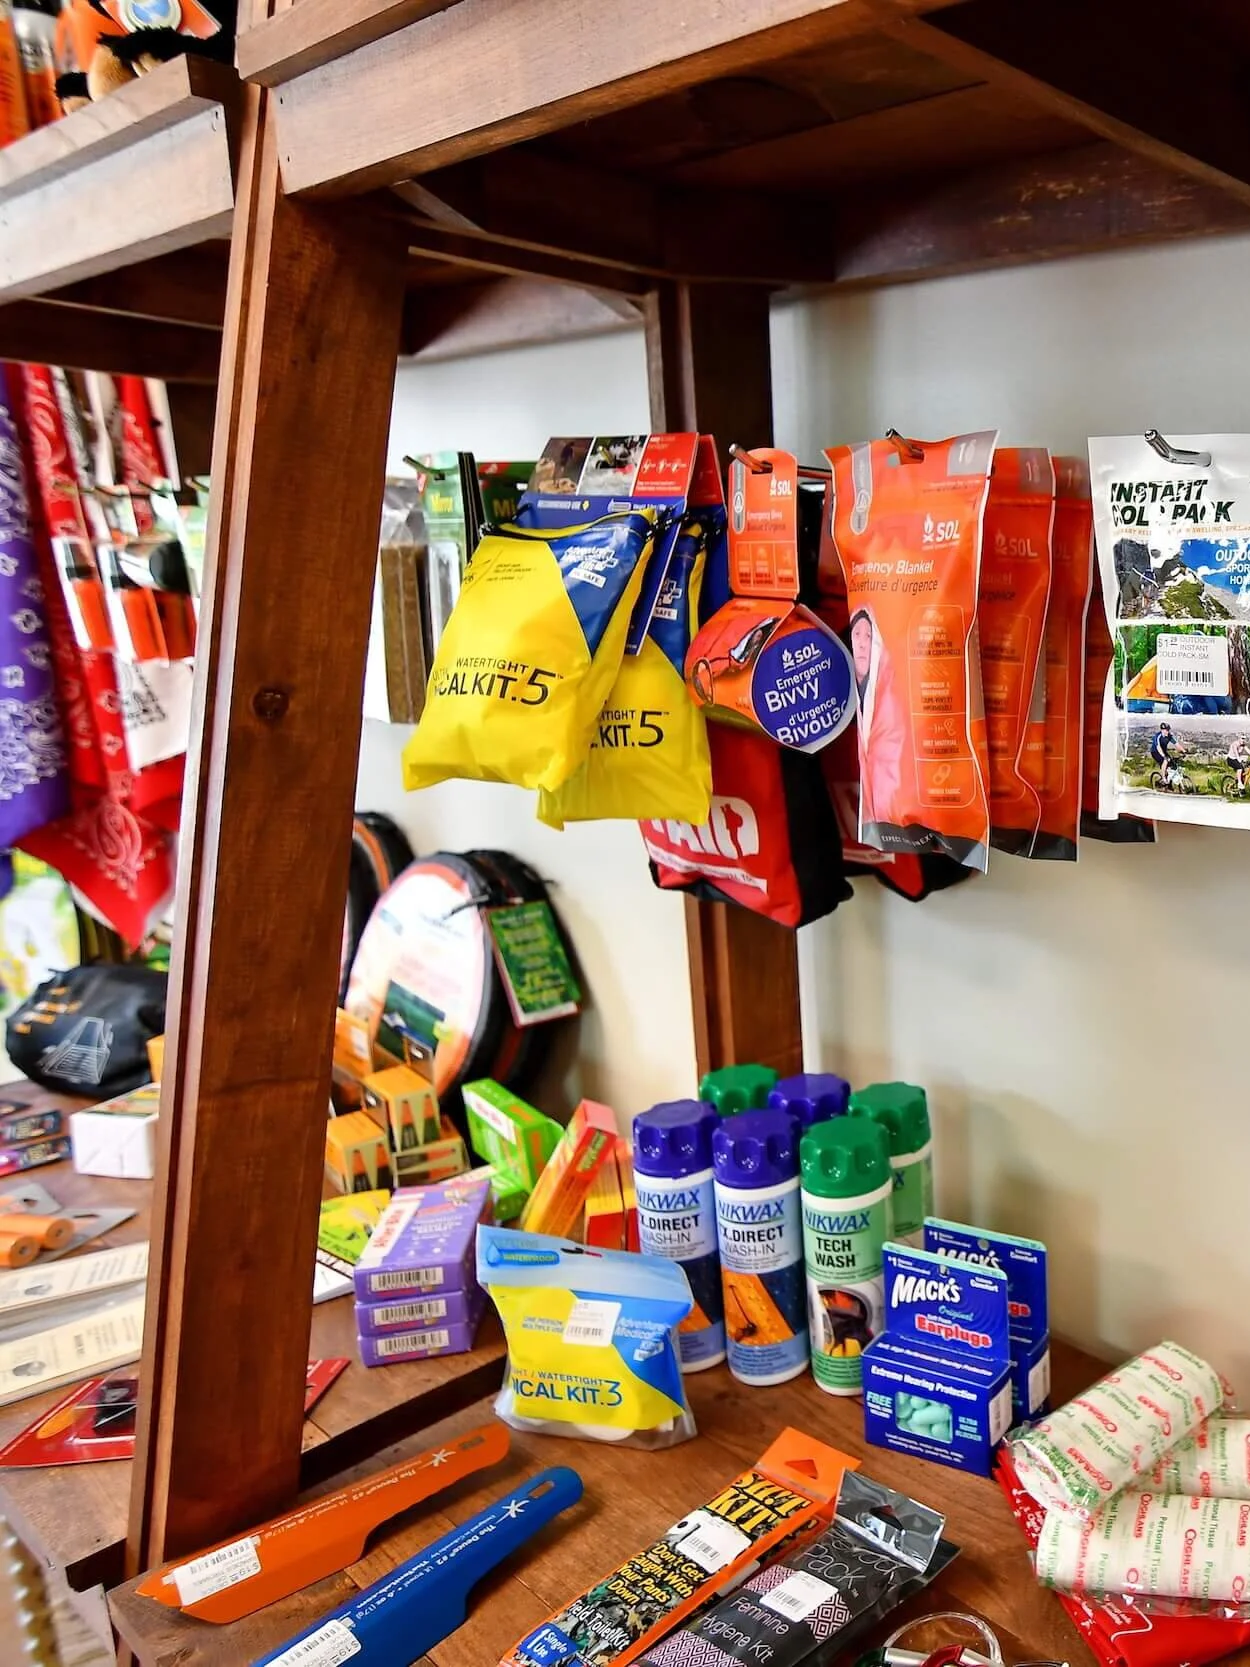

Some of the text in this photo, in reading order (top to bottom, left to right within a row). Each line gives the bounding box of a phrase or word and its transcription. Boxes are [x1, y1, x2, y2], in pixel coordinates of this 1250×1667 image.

[776, 479, 793, 497] SOL
[1111, 504, 1166, 527] COL
[936, 519, 960, 543] SOL
[1008, 538, 1038, 558] SOL
[896, 559, 934, 575] Blanket
[891, 579, 938, 596] d'urgence
[795, 643, 820, 664] SOL
[456, 656, 529, 675] WATERTIGHT
[776, 657, 832, 689] Emergency
[765, 676, 820, 712] Bivvy
[789, 696, 837, 726] d'Urgence
[718, 1199, 785, 1221] NIKWAX
[804, 1210, 870, 1235] NIKWAX
[815, 1236, 852, 1253] TECH
[815, 1254, 857, 1269] WASH
[891, 1273, 961, 1309] MACK'S
[939, 1305, 974, 1322] Original
[914, 1313, 993, 1348] Earplugs
[538, 1370, 605, 1387] WATERTIGHT
[870, 1365, 978, 1402] Extreme Hearing Protection
[866, 1390, 893, 1409] FREE
[706, 1489, 779, 1534] KIT
[479, 1524, 497, 1536] The
[1155, 1516, 1168, 1554] Personal
[680, 1560, 705, 1582] Get
[616, 1563, 671, 1604] Your Pants
[666, 1570, 694, 1599] With
[588, 1611, 615, 1642] Toilet
[729, 1596, 790, 1636] Feminine
[532, 1641, 549, 1658] Use
[543, 1631, 568, 1654] Single
[700, 1613, 776, 1665] Hygiene Kit
